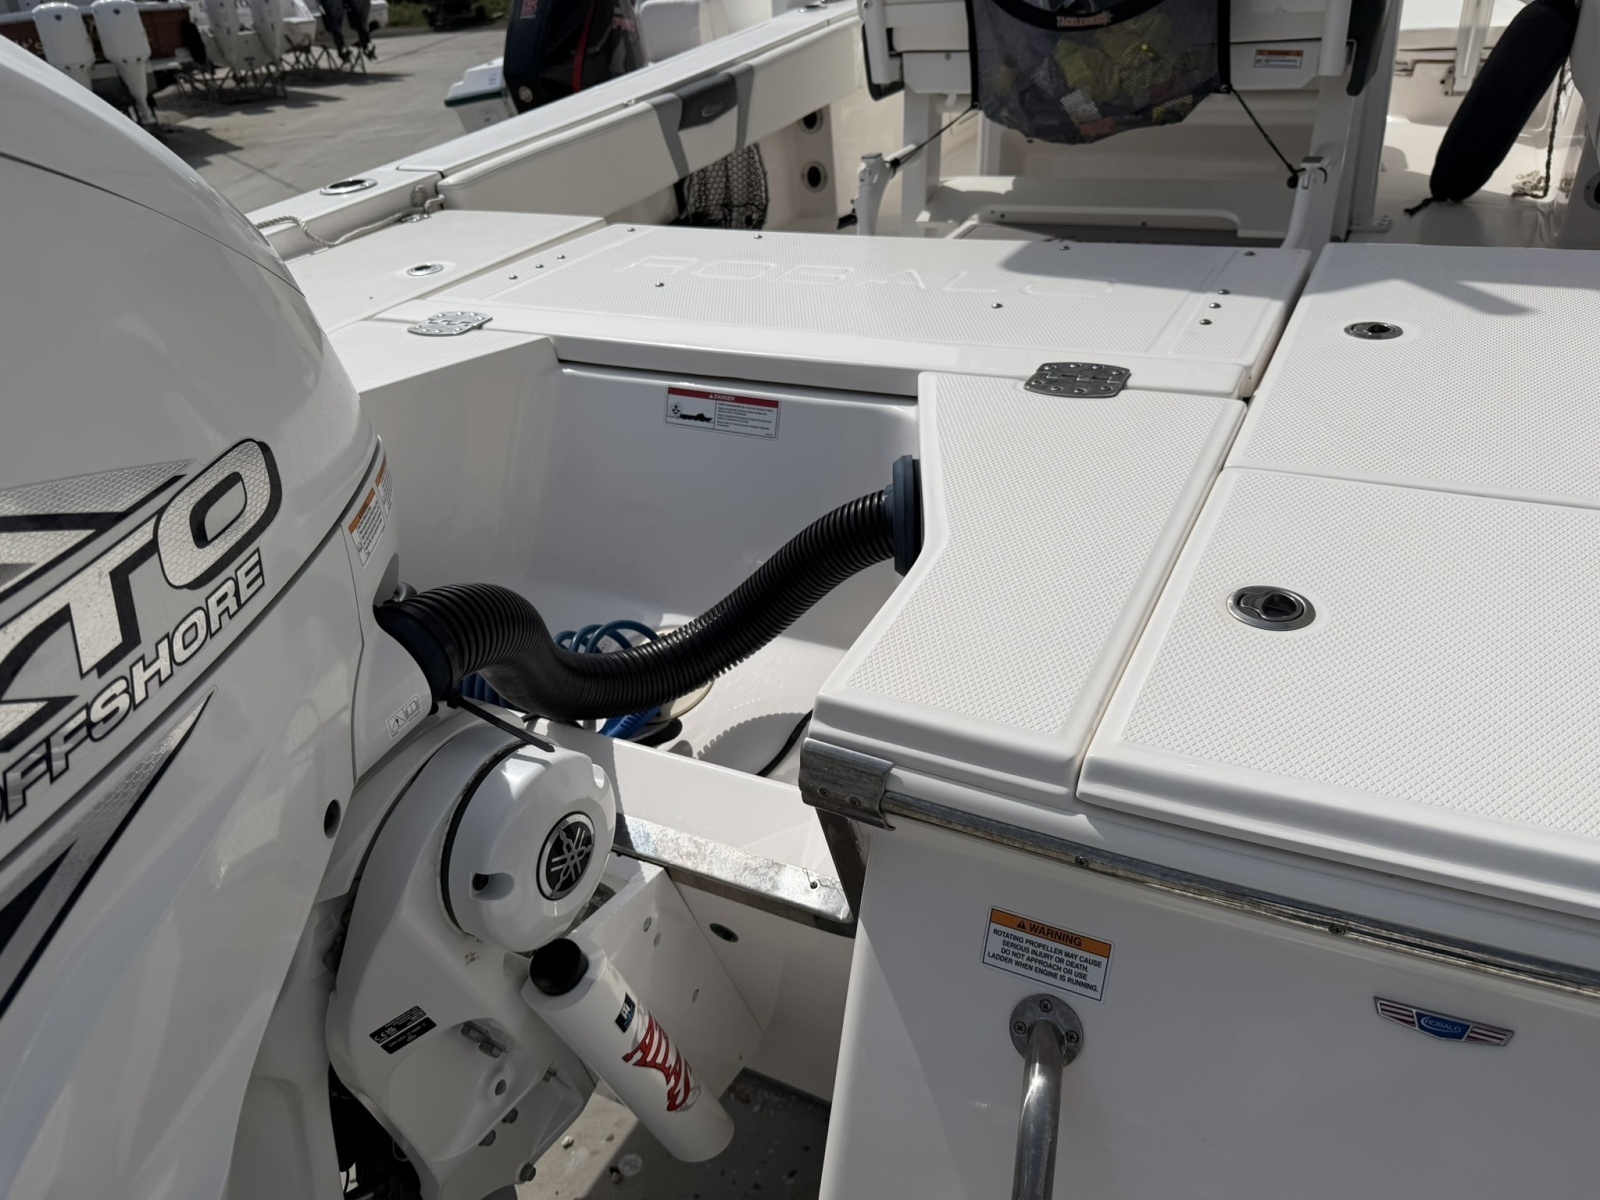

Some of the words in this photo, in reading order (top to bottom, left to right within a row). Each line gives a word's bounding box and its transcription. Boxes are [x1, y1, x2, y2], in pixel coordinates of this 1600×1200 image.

[0, 547, 266, 822] FFSHORE
[993, 928, 1024, 943] ROTATING
[1025, 939, 1063, 955] PROPELLER
[1064, 950, 1078, 960] MAY
[1079, 955, 1102, 968] CAUSE
[1029, 923, 1082, 947] WARNING
[987, 951, 1014, 965] LADDER
[1014, 959, 1034, 972] WHEN
[1034, 966, 1059, 980] ENGINE
[1059, 974, 1067, 982] IS
[1067, 977, 1098, 992] RUNNING.
[1000, 947, 1011, 956] DO
[1011, 950, 1026, 961] NOT
[1026, 955, 1062, 972] APPROACH
[1063, 967, 1073, 976] OR
[1074, 971, 1088, 980] USE
[1002, 940, 1029, 954] SERIOUS
[1031, 949, 1053, 961] INJURY
[1054, 956, 1065, 965] OR
[1066, 960, 1088, 972] DEATH.
[1424, 1018, 1462, 1032] ROBALO
